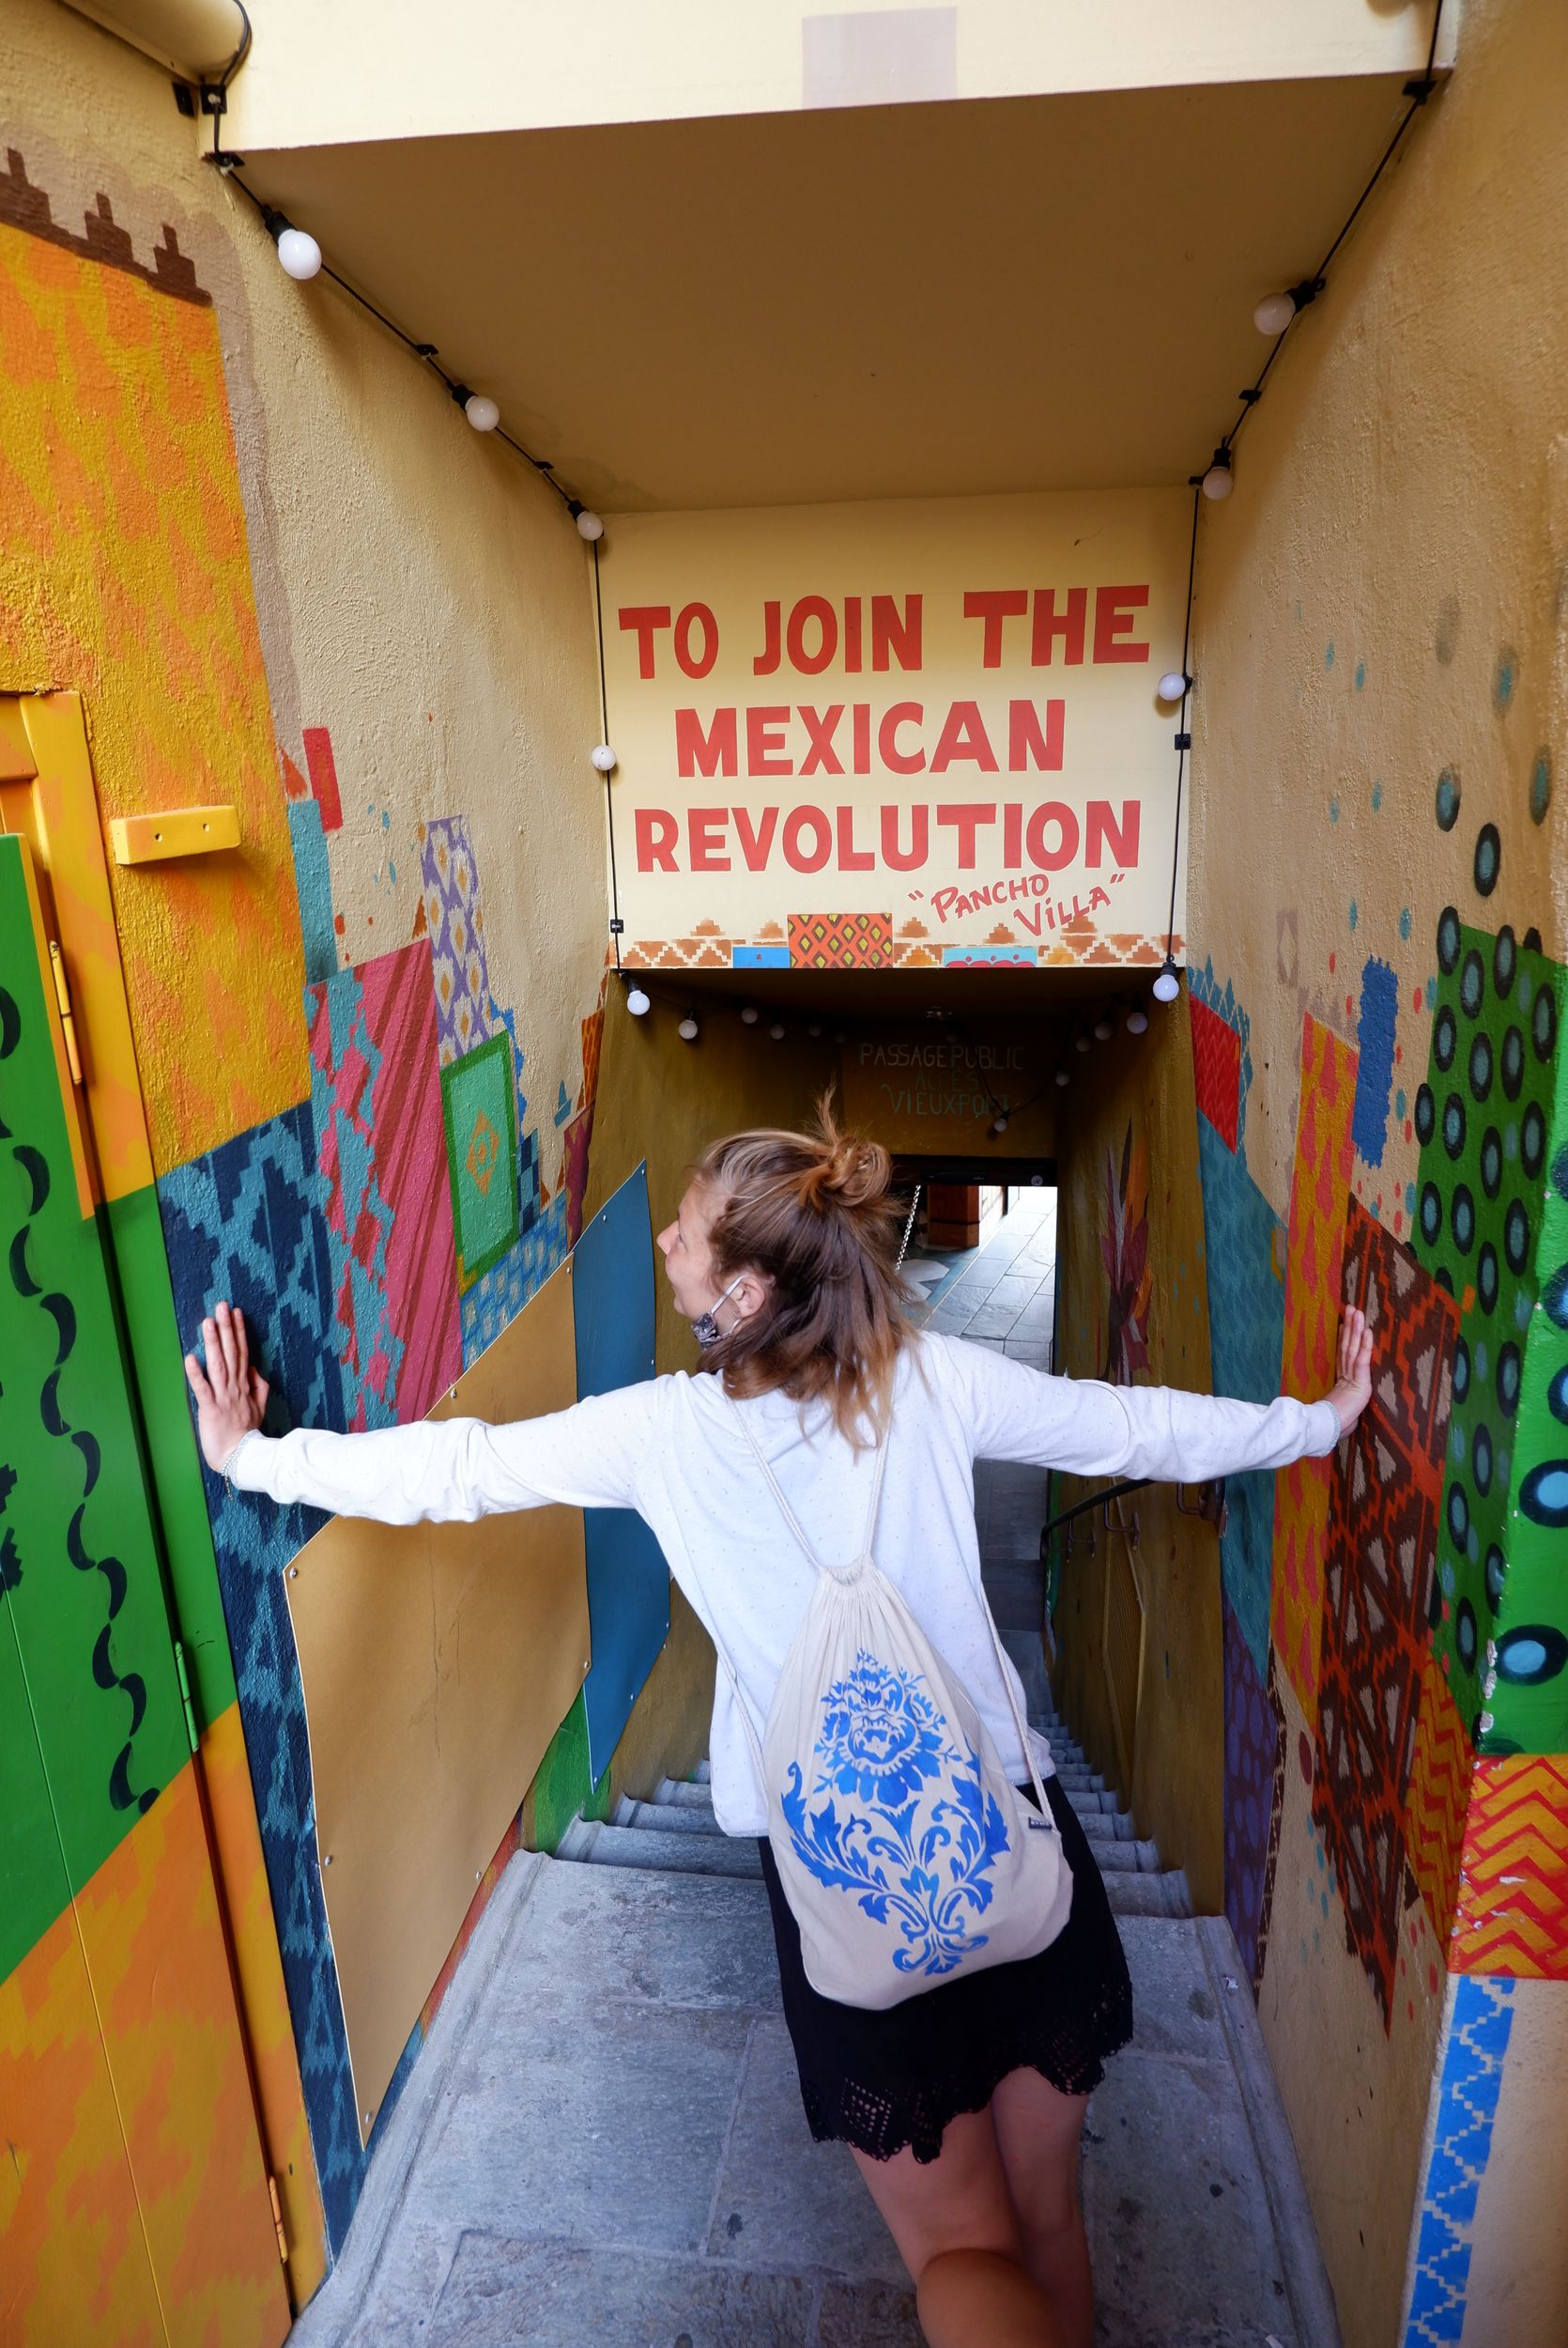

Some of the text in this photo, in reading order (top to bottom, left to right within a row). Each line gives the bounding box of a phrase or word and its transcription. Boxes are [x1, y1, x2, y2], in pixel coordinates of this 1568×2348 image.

[620, 586, 1149, 678] TO JOIN THE
[676, 700, 1065, 777] MEXICAN
[636, 801, 1140, 873] REVOLUTION
[859, 1043, 1024, 1071] PASSAGE PUBLIC
